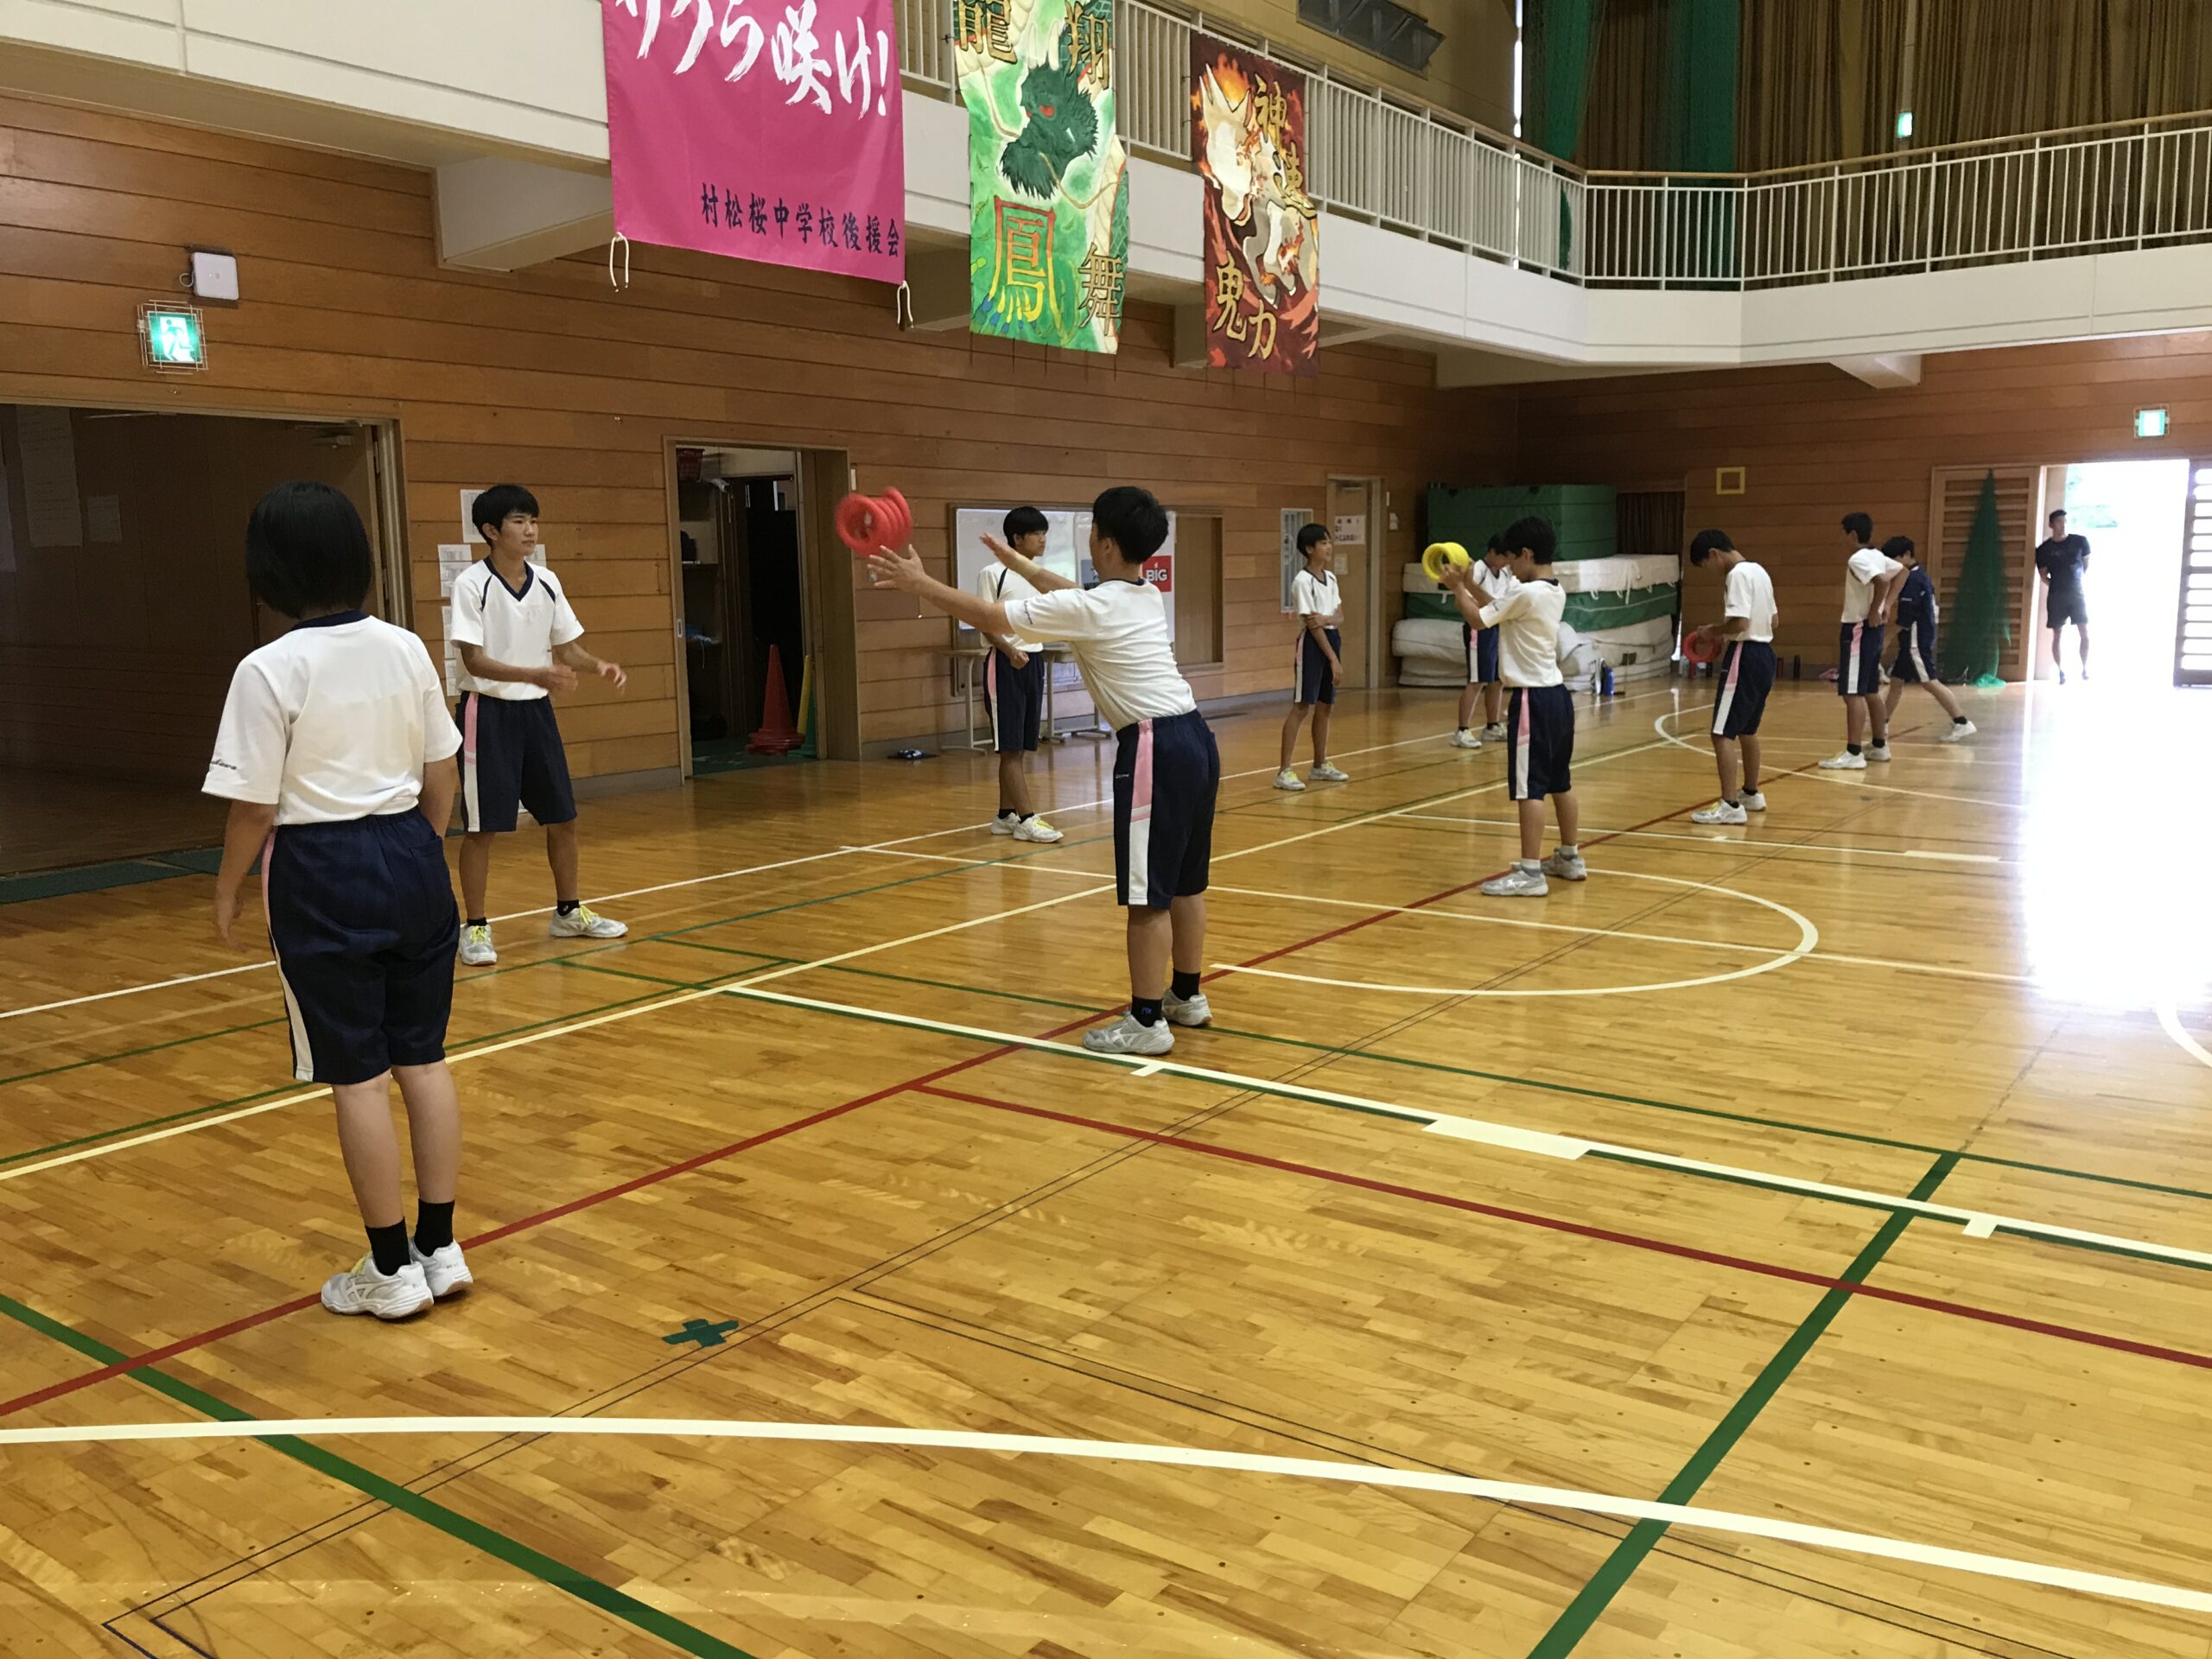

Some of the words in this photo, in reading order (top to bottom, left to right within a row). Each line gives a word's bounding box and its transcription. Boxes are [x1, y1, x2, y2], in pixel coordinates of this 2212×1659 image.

[701, 182, 899, 257] 村松桜中学校後援会
